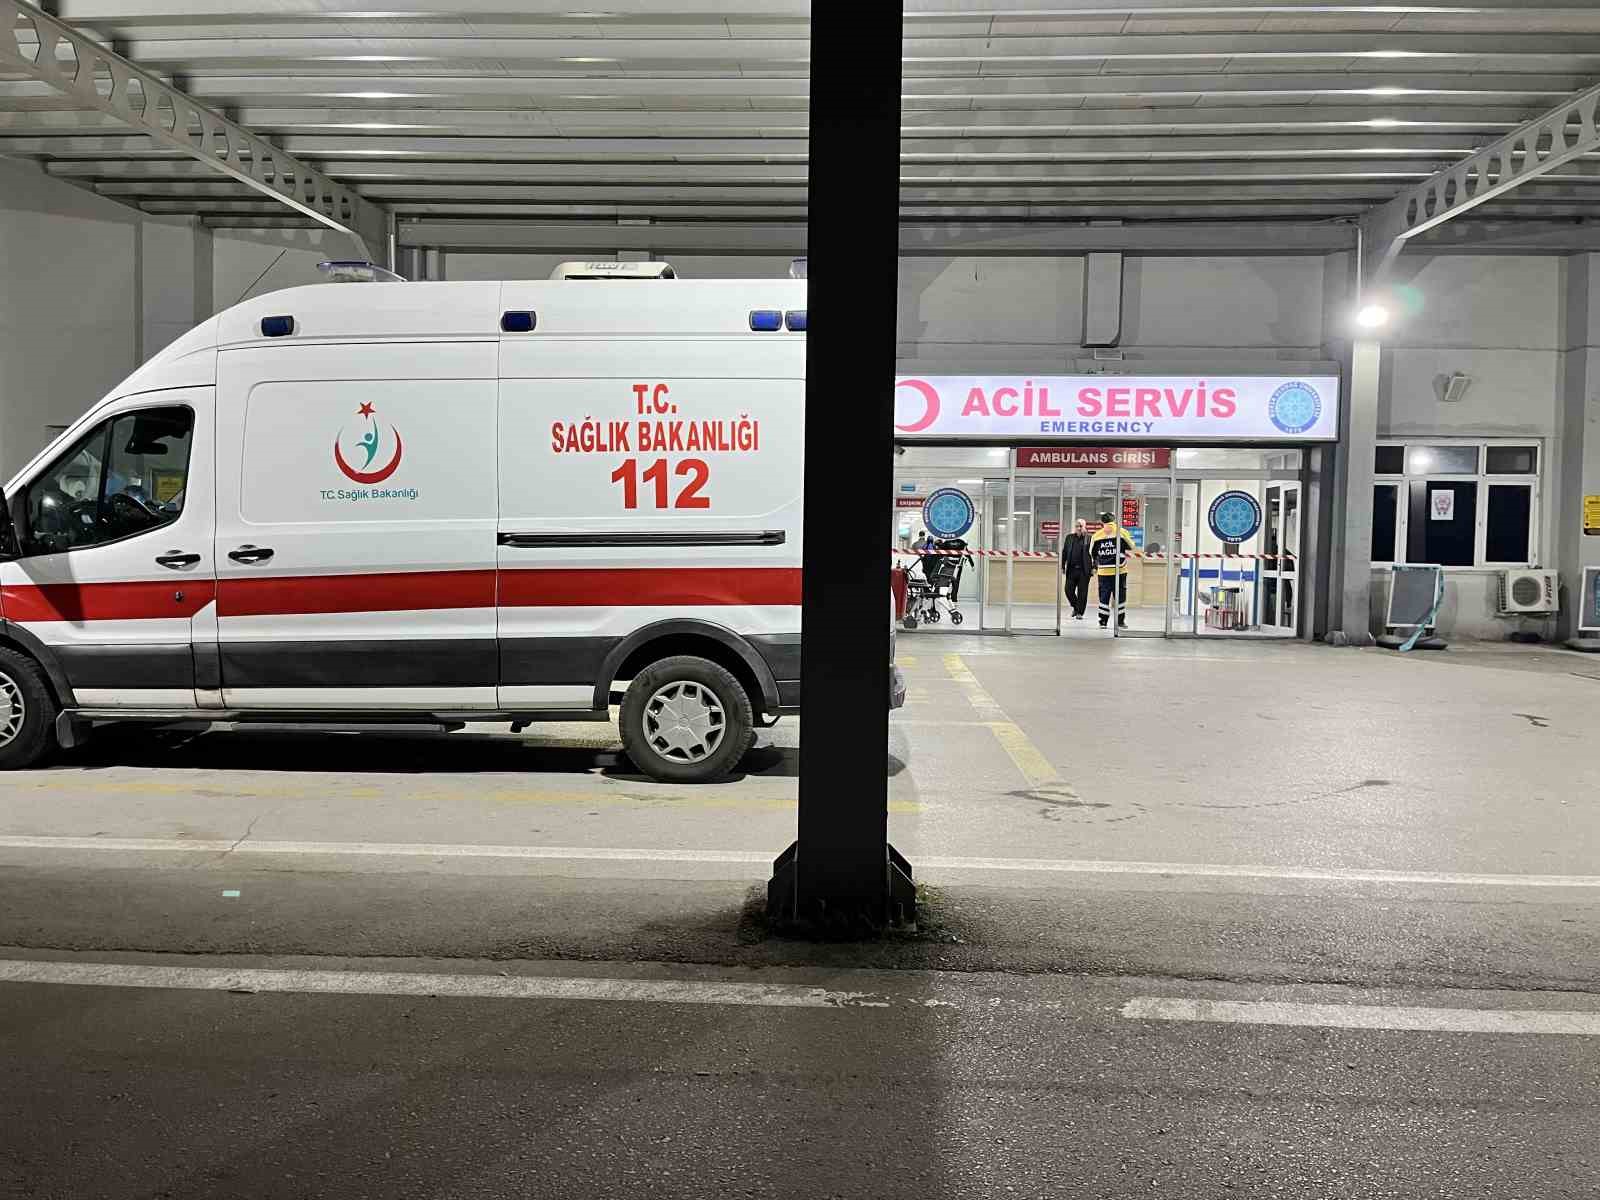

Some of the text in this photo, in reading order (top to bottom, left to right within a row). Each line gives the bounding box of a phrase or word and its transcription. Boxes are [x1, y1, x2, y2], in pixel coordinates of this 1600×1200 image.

[633, 384, 677, 414] T.C.
[961, 380, 1061, 417] ACİL
[1076, 381, 1237, 418] SERVİS
[551, 413, 759, 452] SAĞLIK BAKANLIĞI
[1040, 421, 1154, 433] EMERGENCY
[1030, 451, 1156, 466] AMBULANS GİRİŞİ
[337, 489, 369, 501] Sağlık
[371, 488, 419, 500] Bakanlığı
[611, 458, 710, 509] 112
